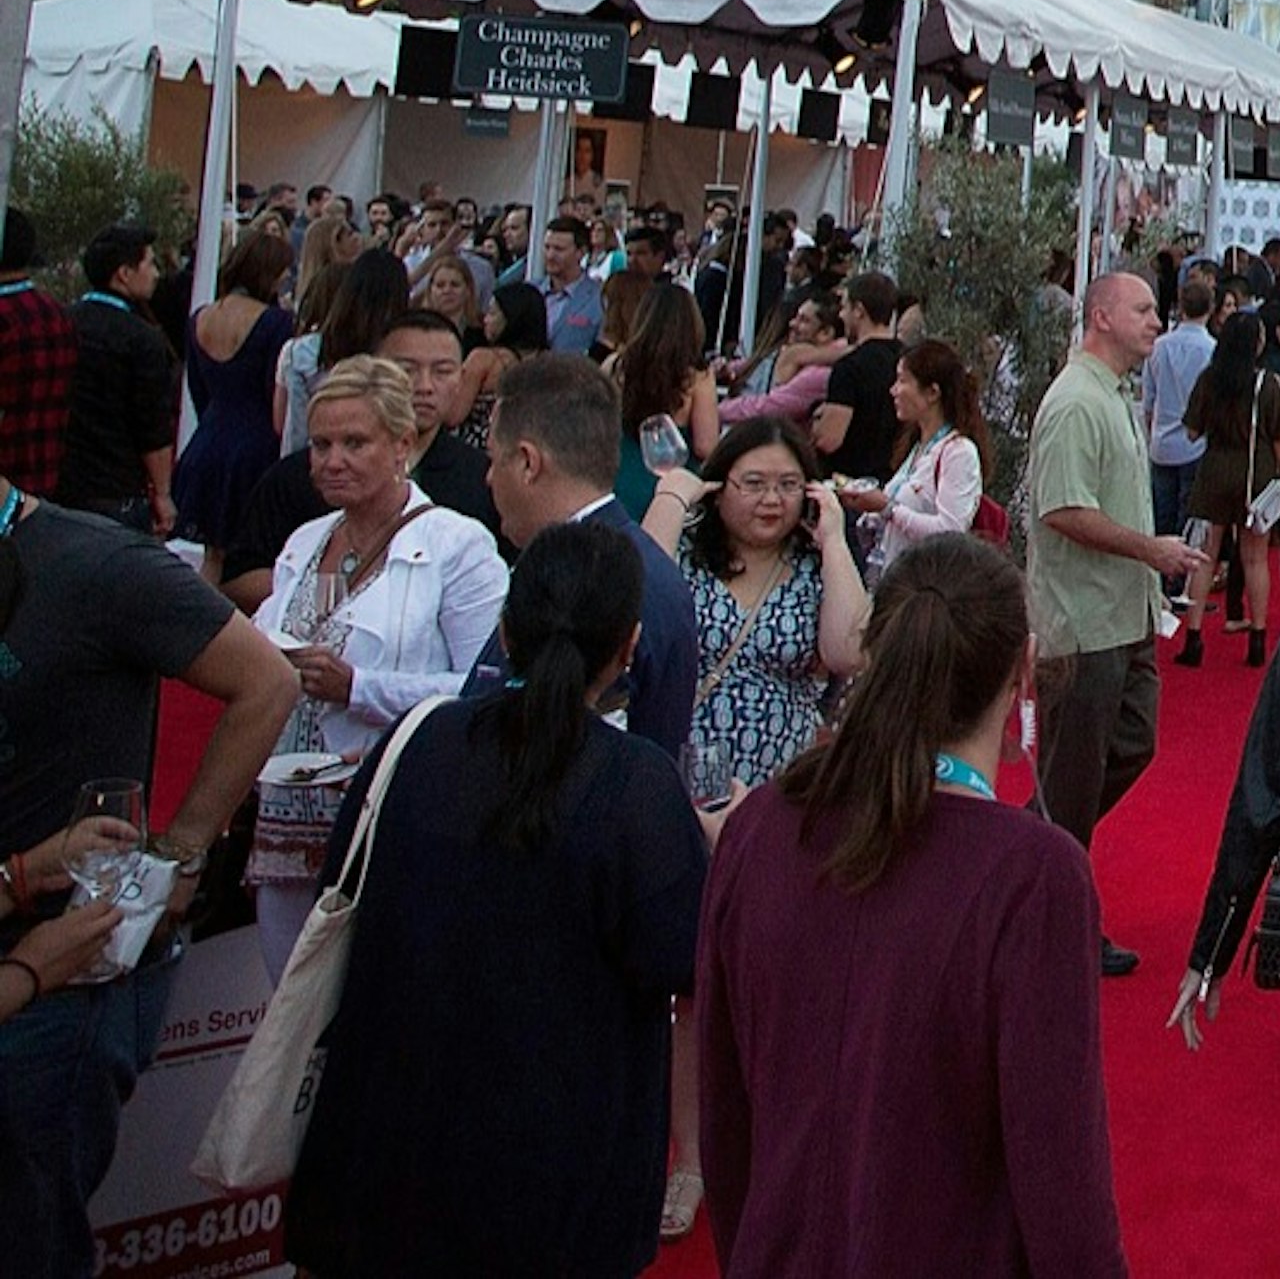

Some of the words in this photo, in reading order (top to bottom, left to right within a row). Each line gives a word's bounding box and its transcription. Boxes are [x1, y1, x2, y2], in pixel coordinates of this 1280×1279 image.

[479, 21, 610, 53] Champagne
[501, 45, 582, 71] Charles
[488, 69, 592, 96] Heidsieck
